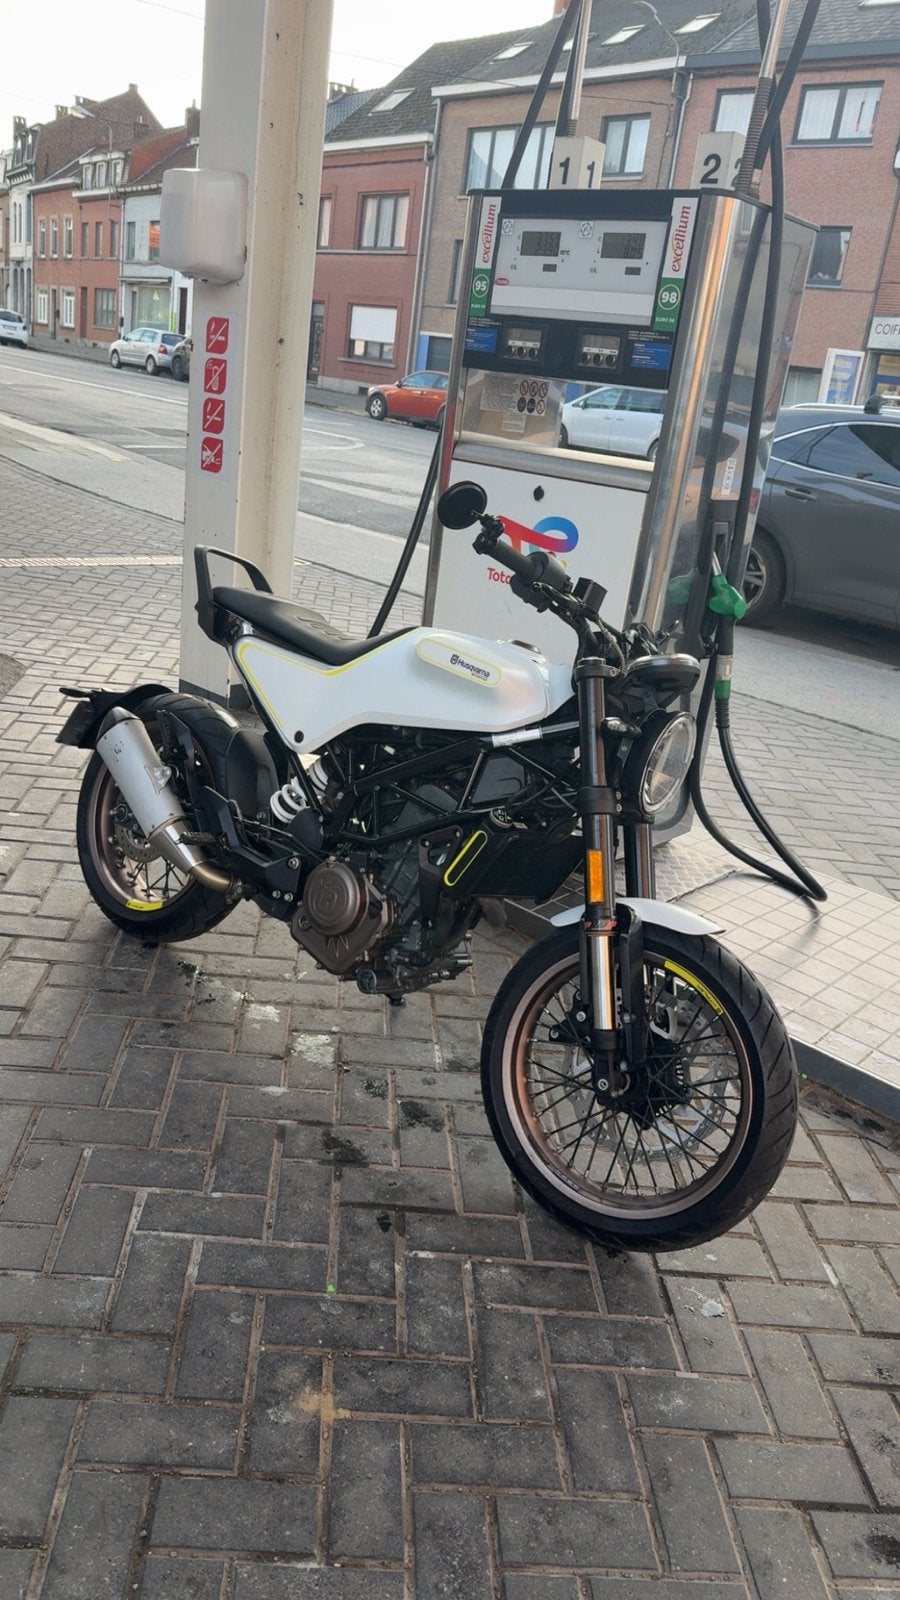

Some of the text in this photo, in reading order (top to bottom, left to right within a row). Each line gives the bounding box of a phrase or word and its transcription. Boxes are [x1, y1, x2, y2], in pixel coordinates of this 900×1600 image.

[559, 157, 570, 186] 1
[586, 160, 596, 189] 1
[700, 153, 721, 184] 2
[482, 203, 497, 264] excellium
[671, 205, 692, 273] excellium
[475, 280, 487, 292] 95
[661, 291, 678, 304] 98
[875, 323, 900, 335] COIF
[457, 659, 490, 678] Husqvarna
